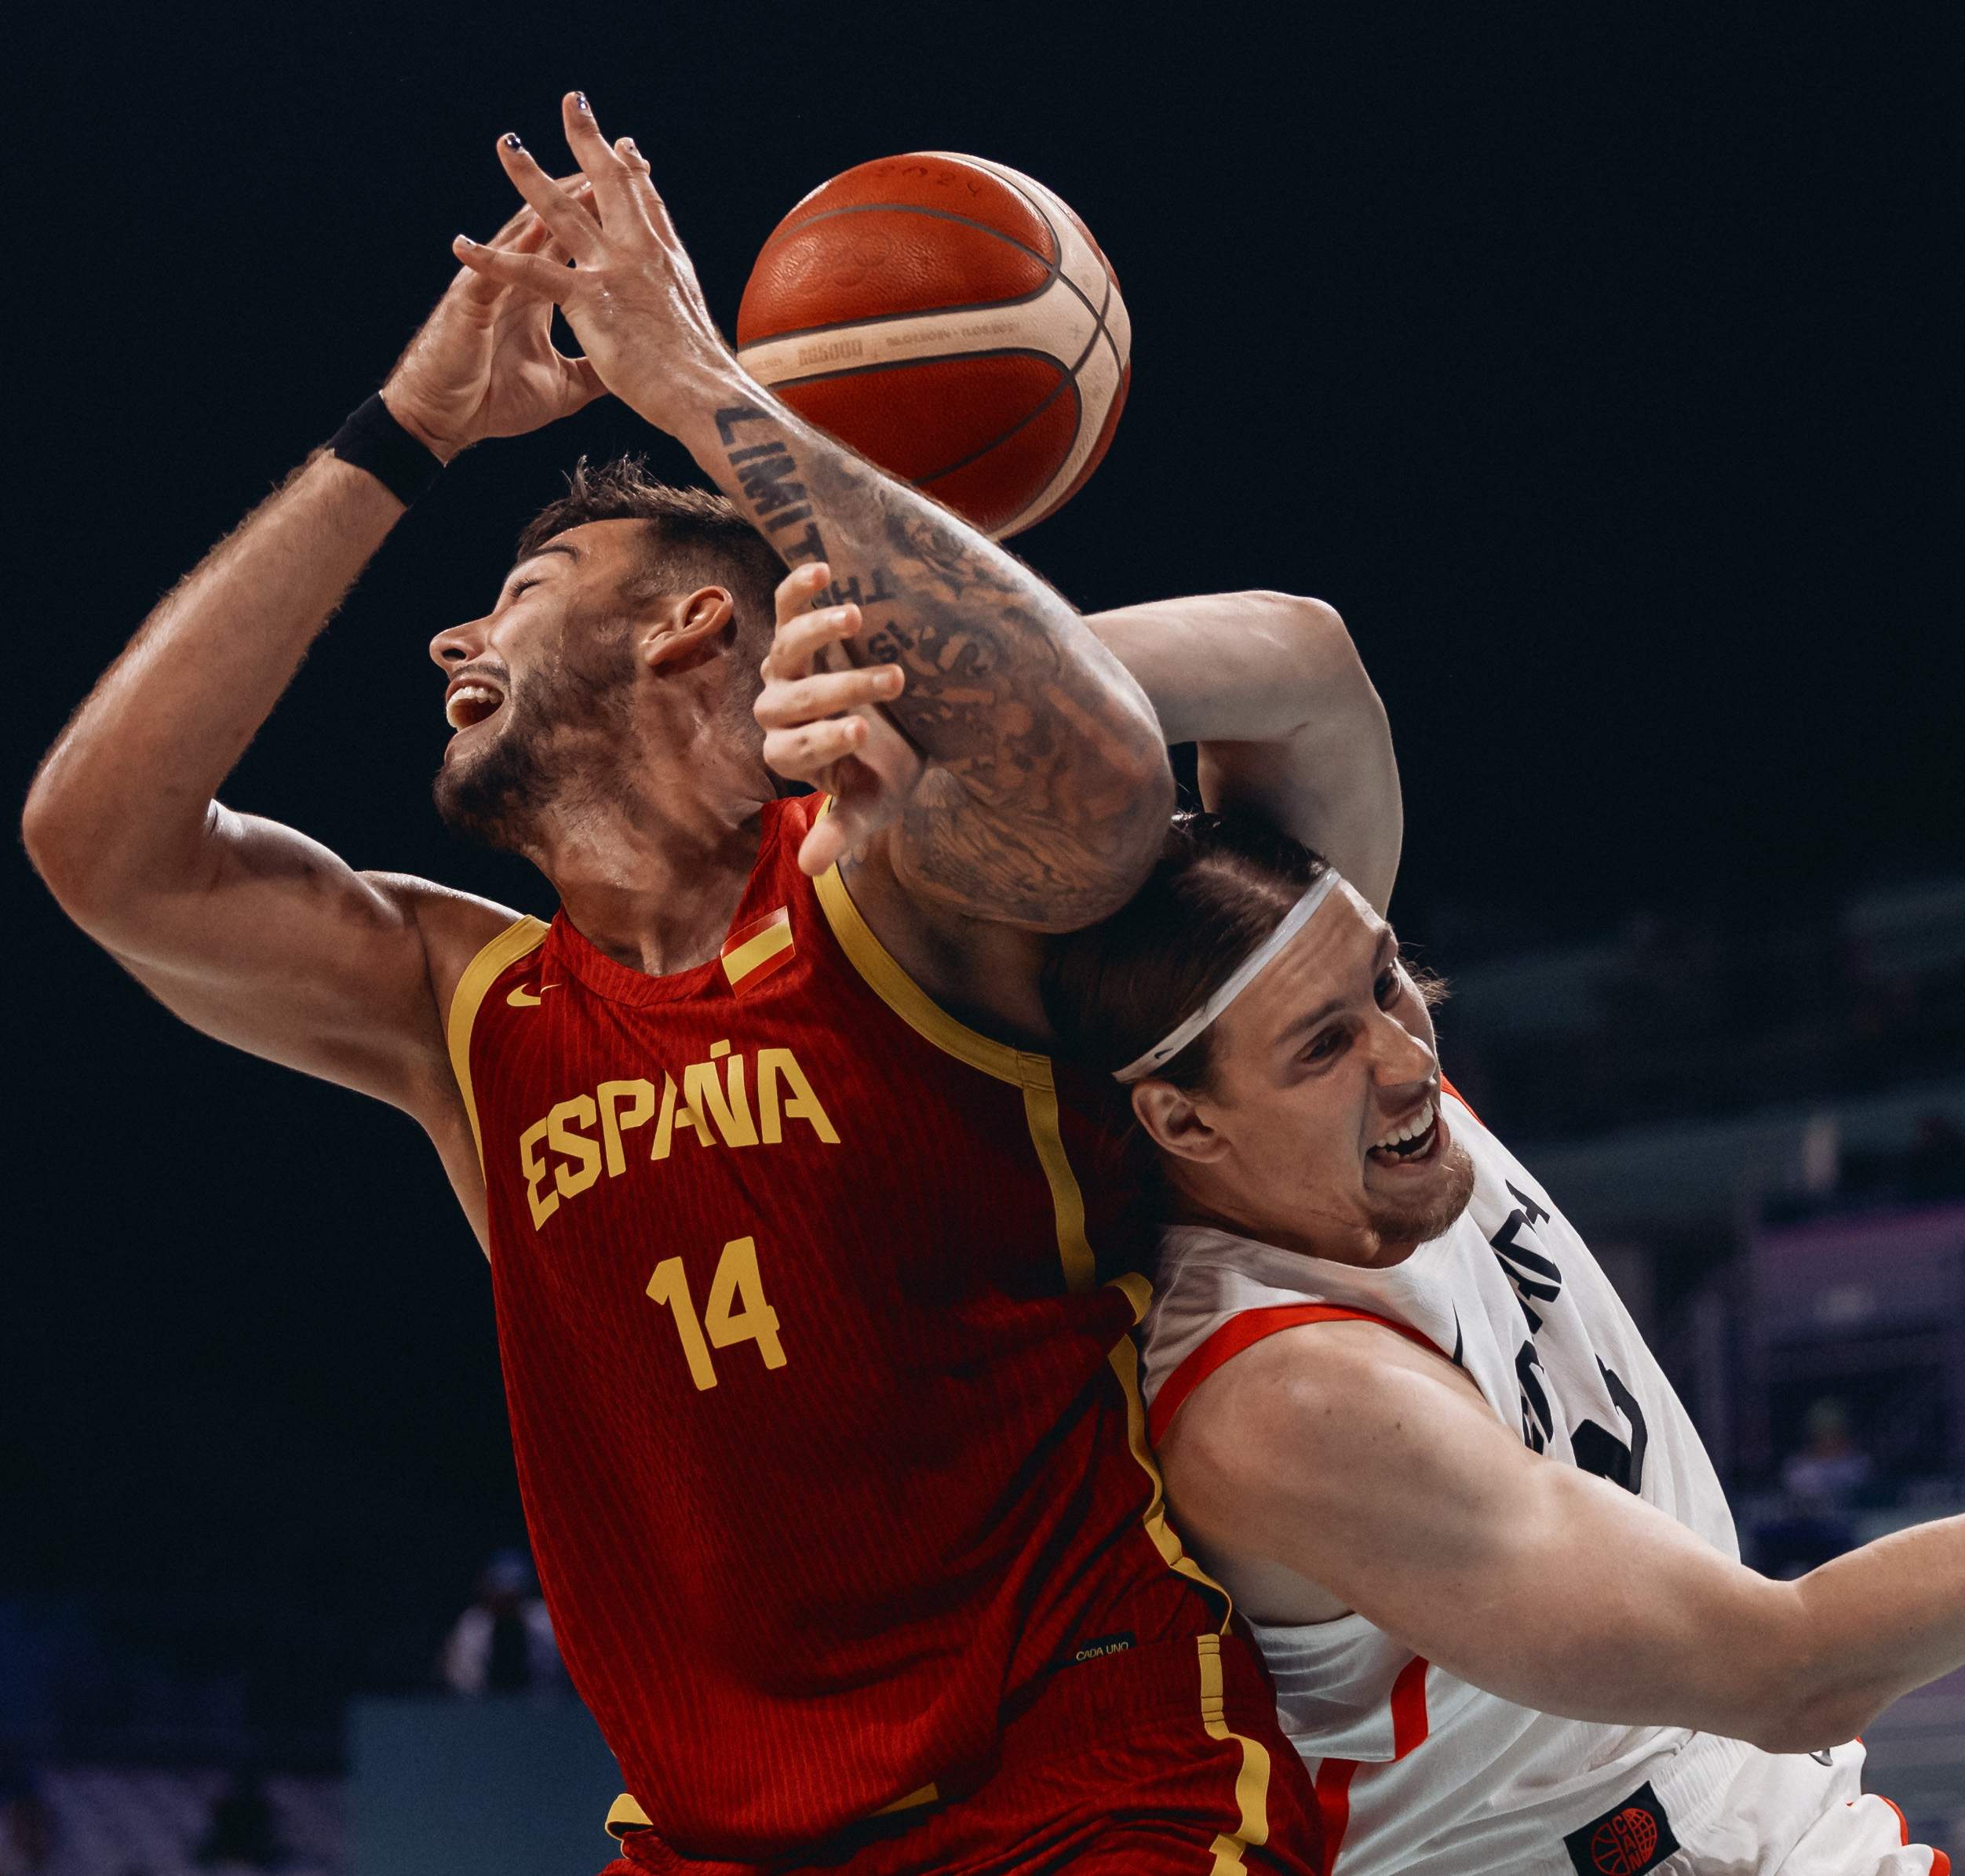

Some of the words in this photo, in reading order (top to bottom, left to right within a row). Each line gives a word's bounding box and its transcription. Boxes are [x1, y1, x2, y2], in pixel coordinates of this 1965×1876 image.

[519, 1038, 841, 1233] ESPAÑA
[645, 1235, 788, 1392] 14
[1077, 1647, 1103, 1661] CADA
[1106, 1641, 1129, 1654] UNO
[1611, 1814, 1643, 1871] CAN
